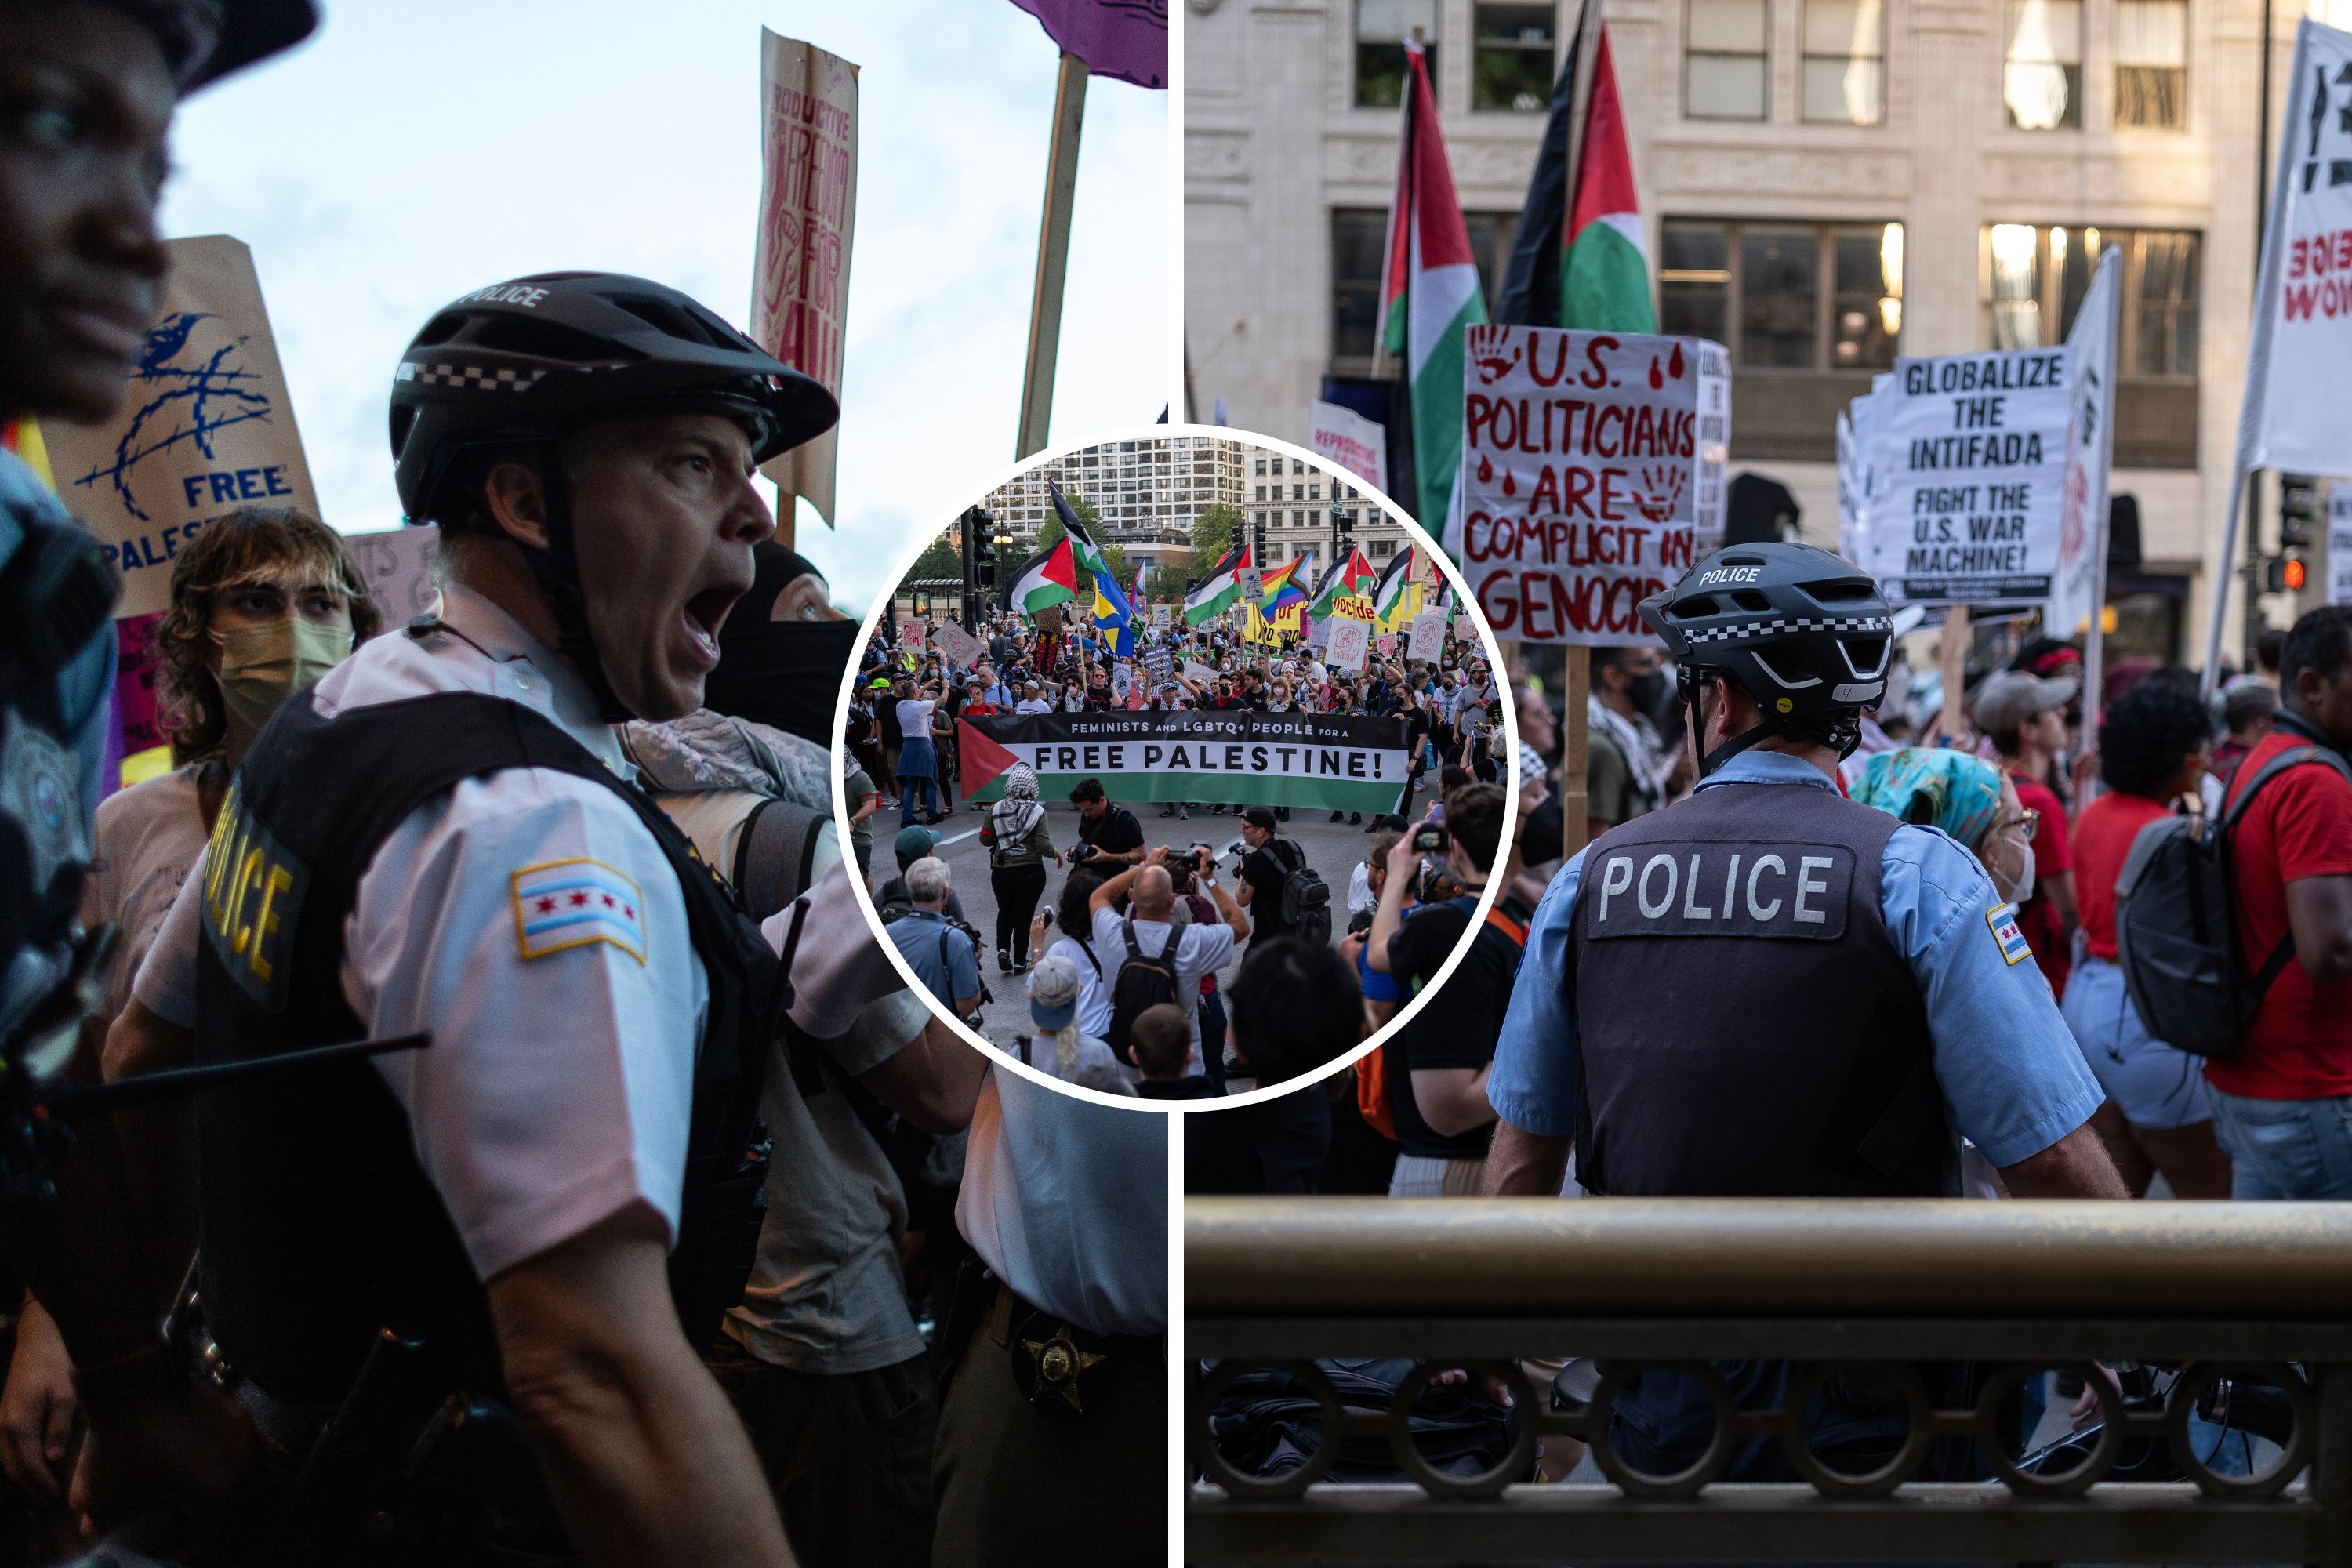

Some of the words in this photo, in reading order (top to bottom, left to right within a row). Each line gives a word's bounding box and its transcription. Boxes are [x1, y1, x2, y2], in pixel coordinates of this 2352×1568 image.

[459, 285, 550, 308] POLICE
[1528, 331, 1622, 389] U.S.
[1905, 355, 2063, 395] GLOBALIZE
[1466, 394, 1696, 458] POLITICIANS
[1953, 397, 2006, 429] THE
[1909, 432, 2045, 470] INTIFADA
[183, 466, 292, 507] FREE
[1528, 464, 1629, 521] ARE
[1912, 485, 1979, 515] FIGHT
[1987, 482, 2034, 511] THE
[100, 517, 221, 572] PALES
[1465, 510, 1650, 566] COMPLICIT
[1661, 528, 1694, 568] IN
[1913, 517, 1958, 544] U.S.
[1968, 516, 2027, 543] WAR
[1698, 568, 1761, 587] POLICE
[1905, 545, 2027, 574] MACHINE!
[1333, 597, 1375, 620] nocide
[1478, 569, 1668, 640] GENOCID
[1145, 655, 1171, 665] GENOCIDE
[1071, 721, 1149, 734] FEMINISTS
[1183, 721, 1245, 735] LGBTQ+
[1252, 722, 1313, 735] PEOPLE
[1319, 728, 1338, 737] FOR
[1341, 729, 1348, 738] A
[1035, 746, 1124, 770] FREE
[1144, 745, 1382, 779] PALESTINE!
[204, 785, 294, 982] POLICE
[1599, 853, 1834, 924] POLICE
